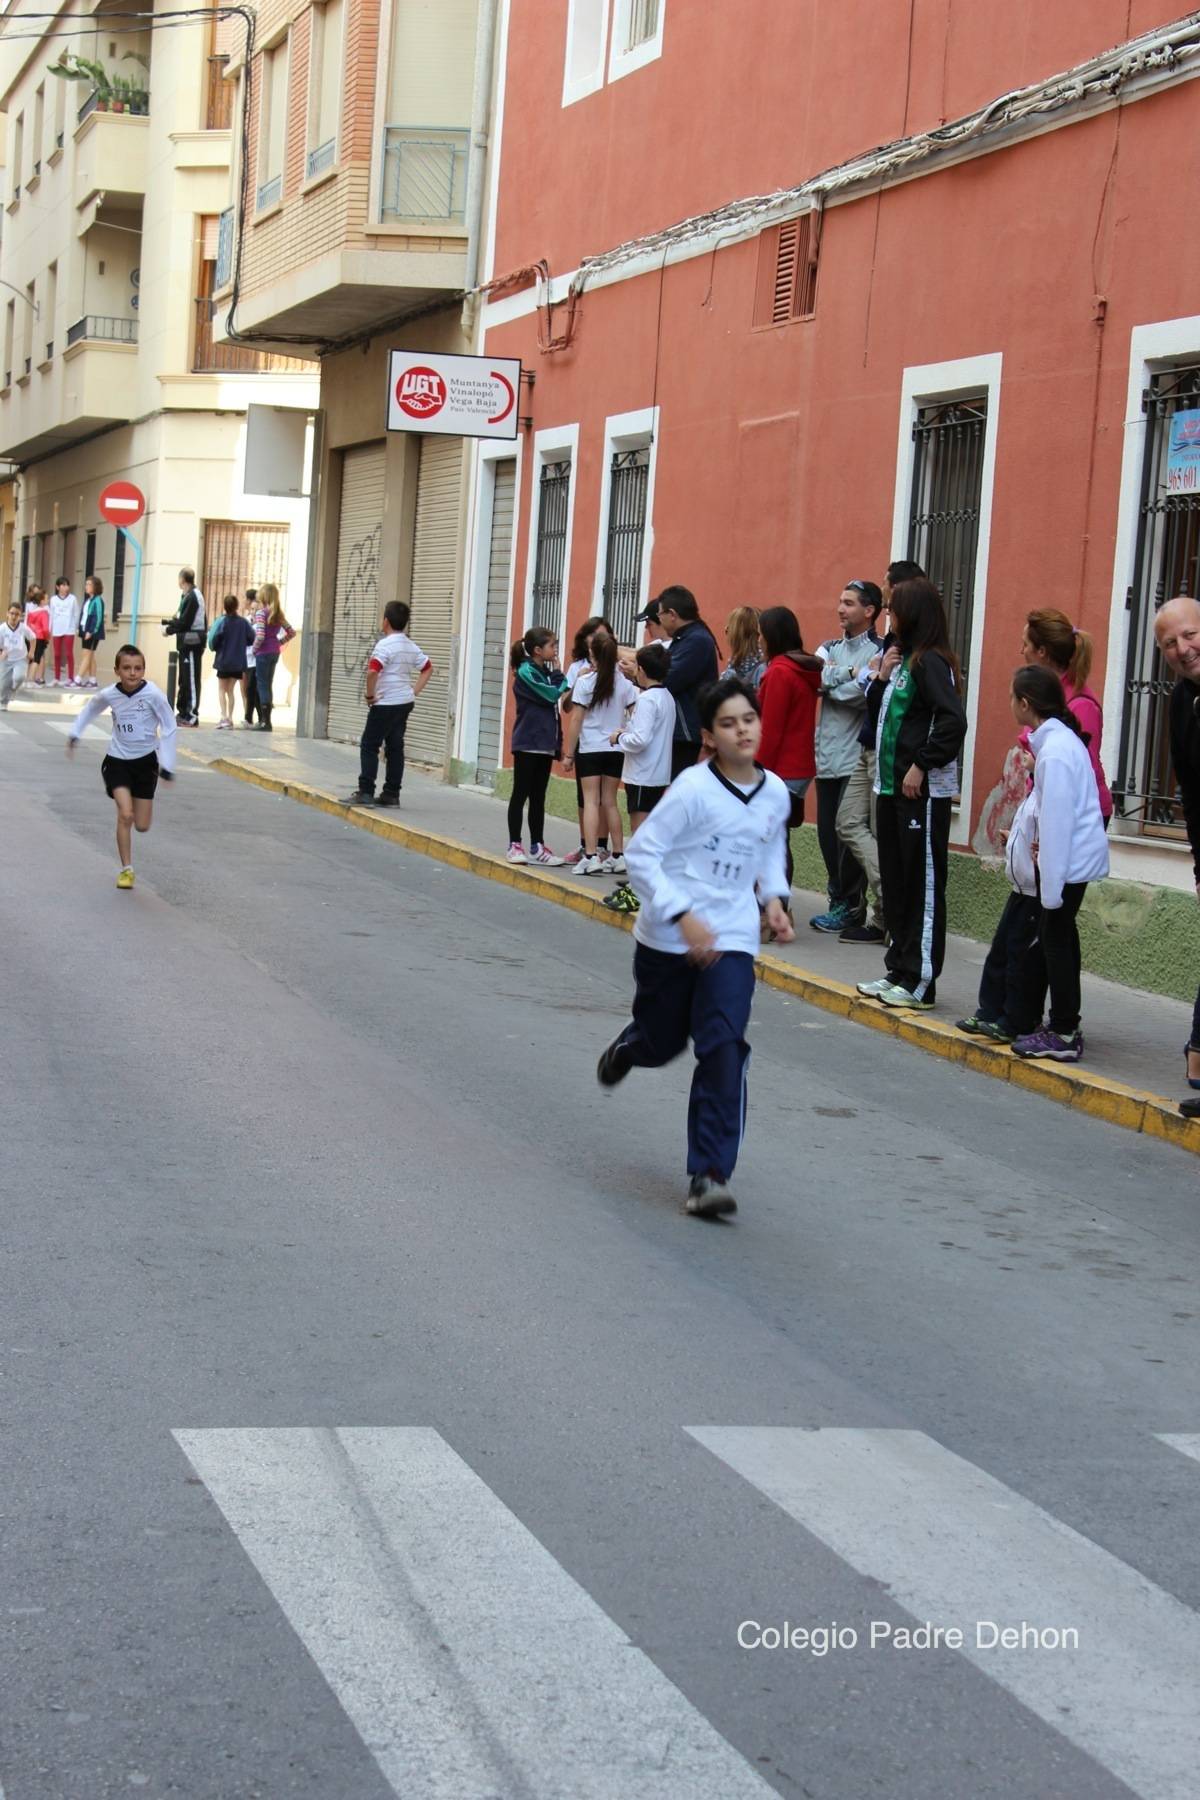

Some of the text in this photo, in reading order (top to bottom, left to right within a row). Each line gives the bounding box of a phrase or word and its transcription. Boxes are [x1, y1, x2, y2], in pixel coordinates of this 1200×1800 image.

[401, 373, 441, 397] UGT
[450, 378, 500, 390] Muntanya
[450, 387, 494, 398] Vinalopó
[449, 396, 497, 408] Vega Baja
[116, 723, 134, 734] 118
[711, 859, 743, 881] 111
